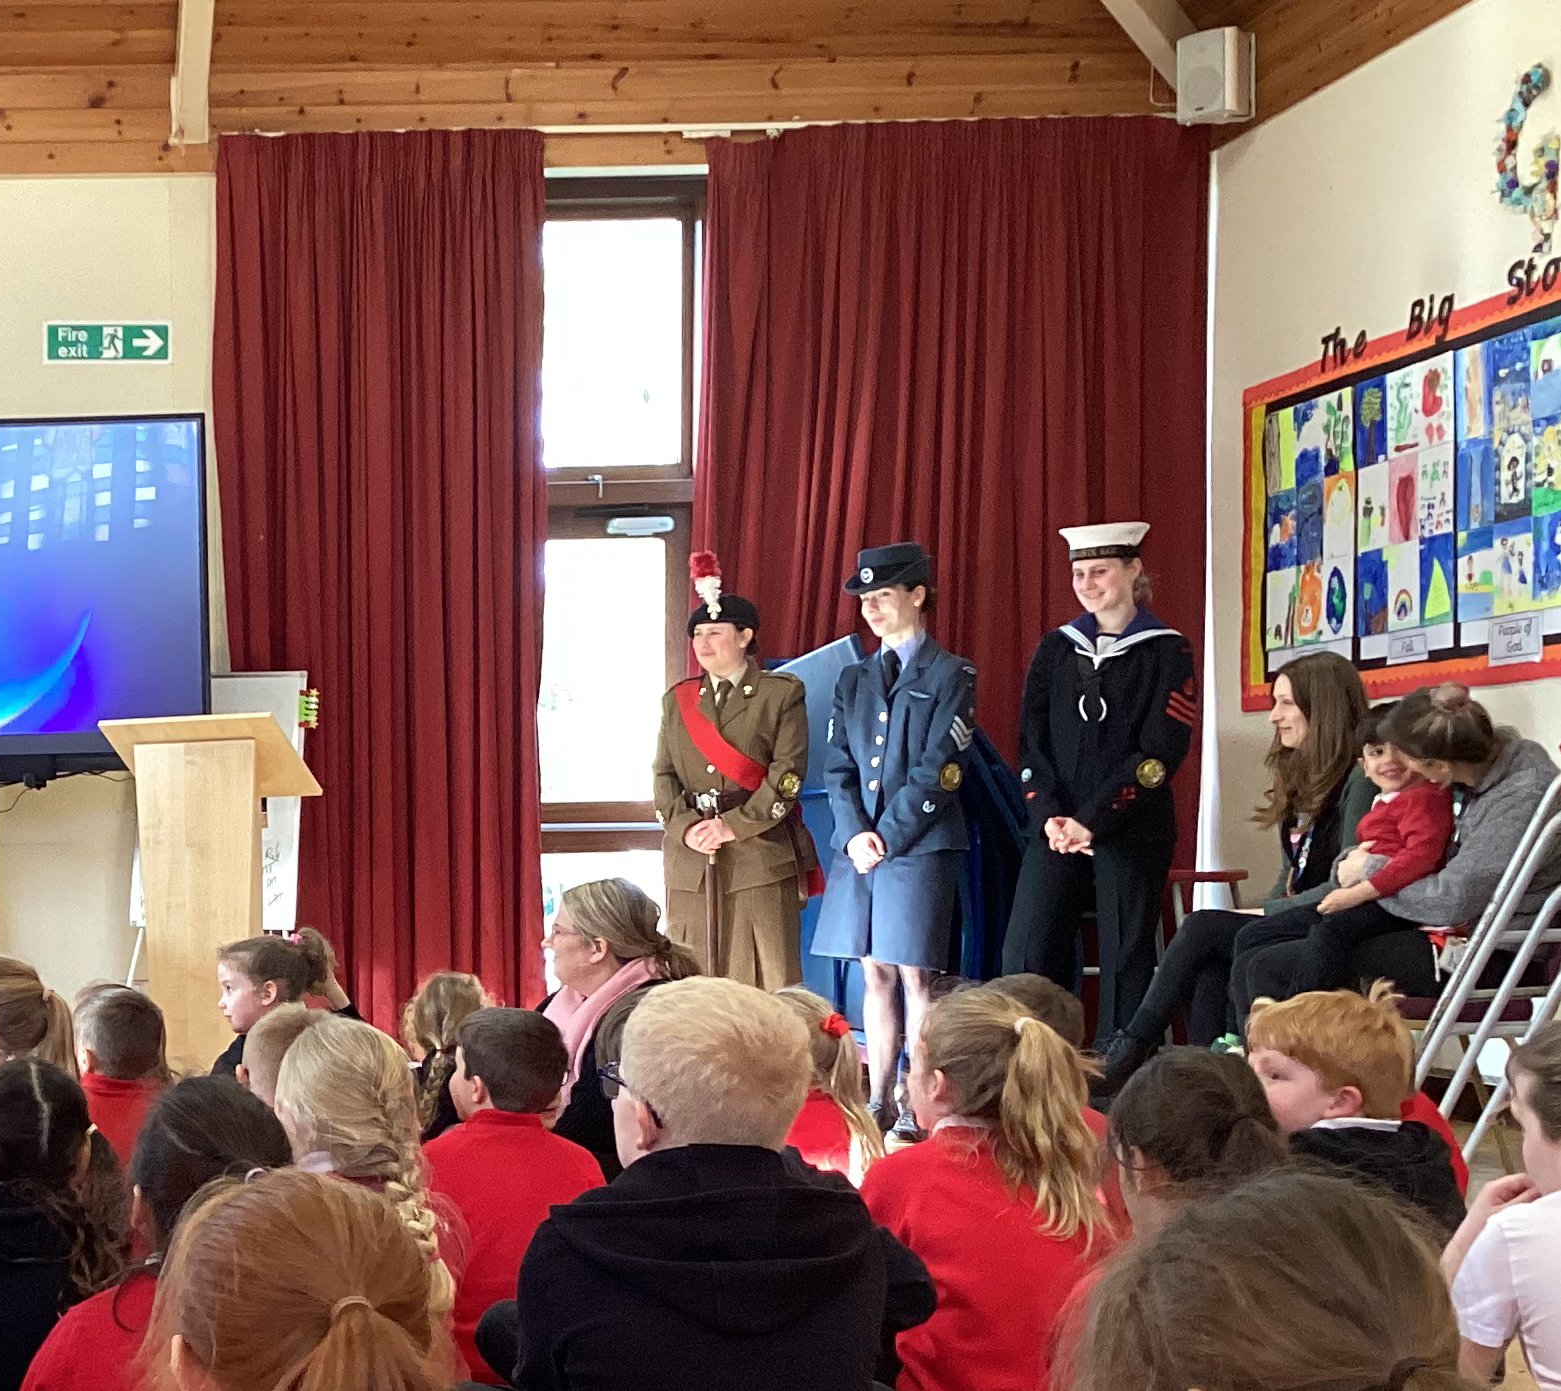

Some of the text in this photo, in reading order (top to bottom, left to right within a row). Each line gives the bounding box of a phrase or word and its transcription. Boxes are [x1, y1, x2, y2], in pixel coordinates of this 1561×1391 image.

[57, 327, 88, 342] Fire
[1320, 325, 1367, 373] The
[1406, 293, 1455, 345] Big
[57, 343, 89, 358] exit
